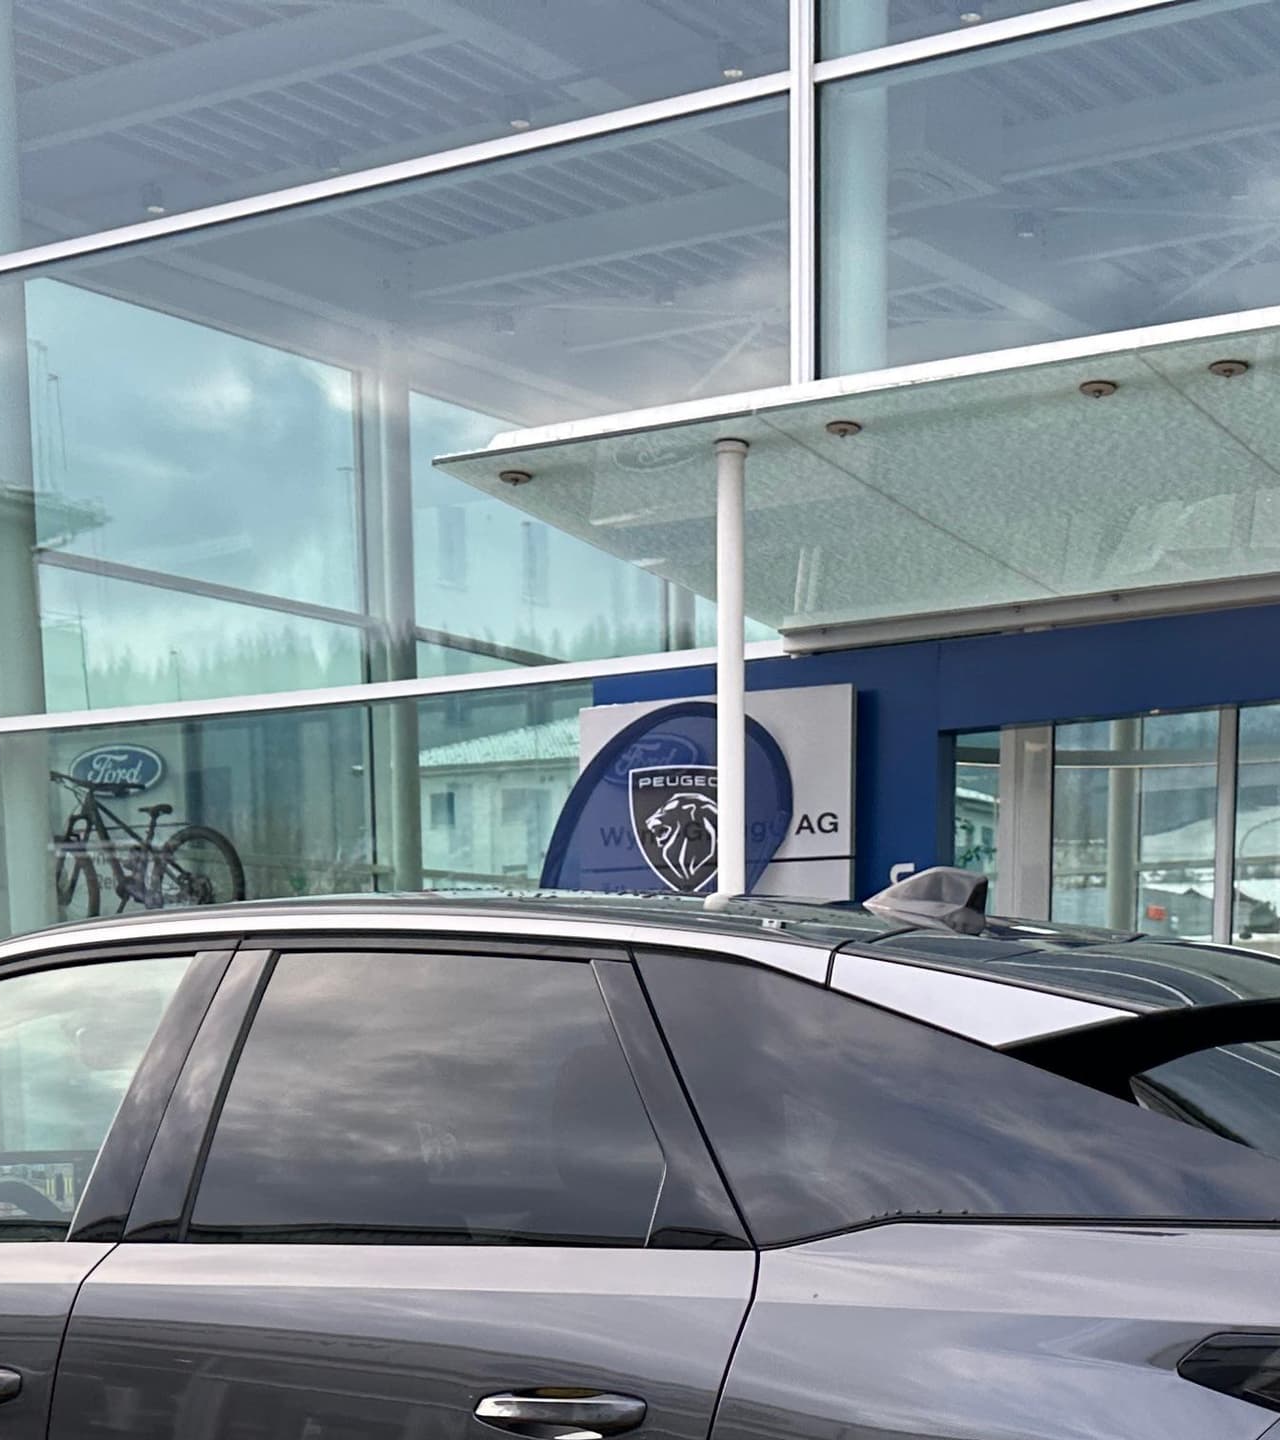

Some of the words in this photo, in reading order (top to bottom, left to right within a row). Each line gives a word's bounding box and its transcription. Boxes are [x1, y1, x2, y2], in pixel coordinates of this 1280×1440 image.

[87, 754, 143, 785] Ford
[638, 775, 718, 789] PEUGEO
[795, 812, 840, 836] AG
